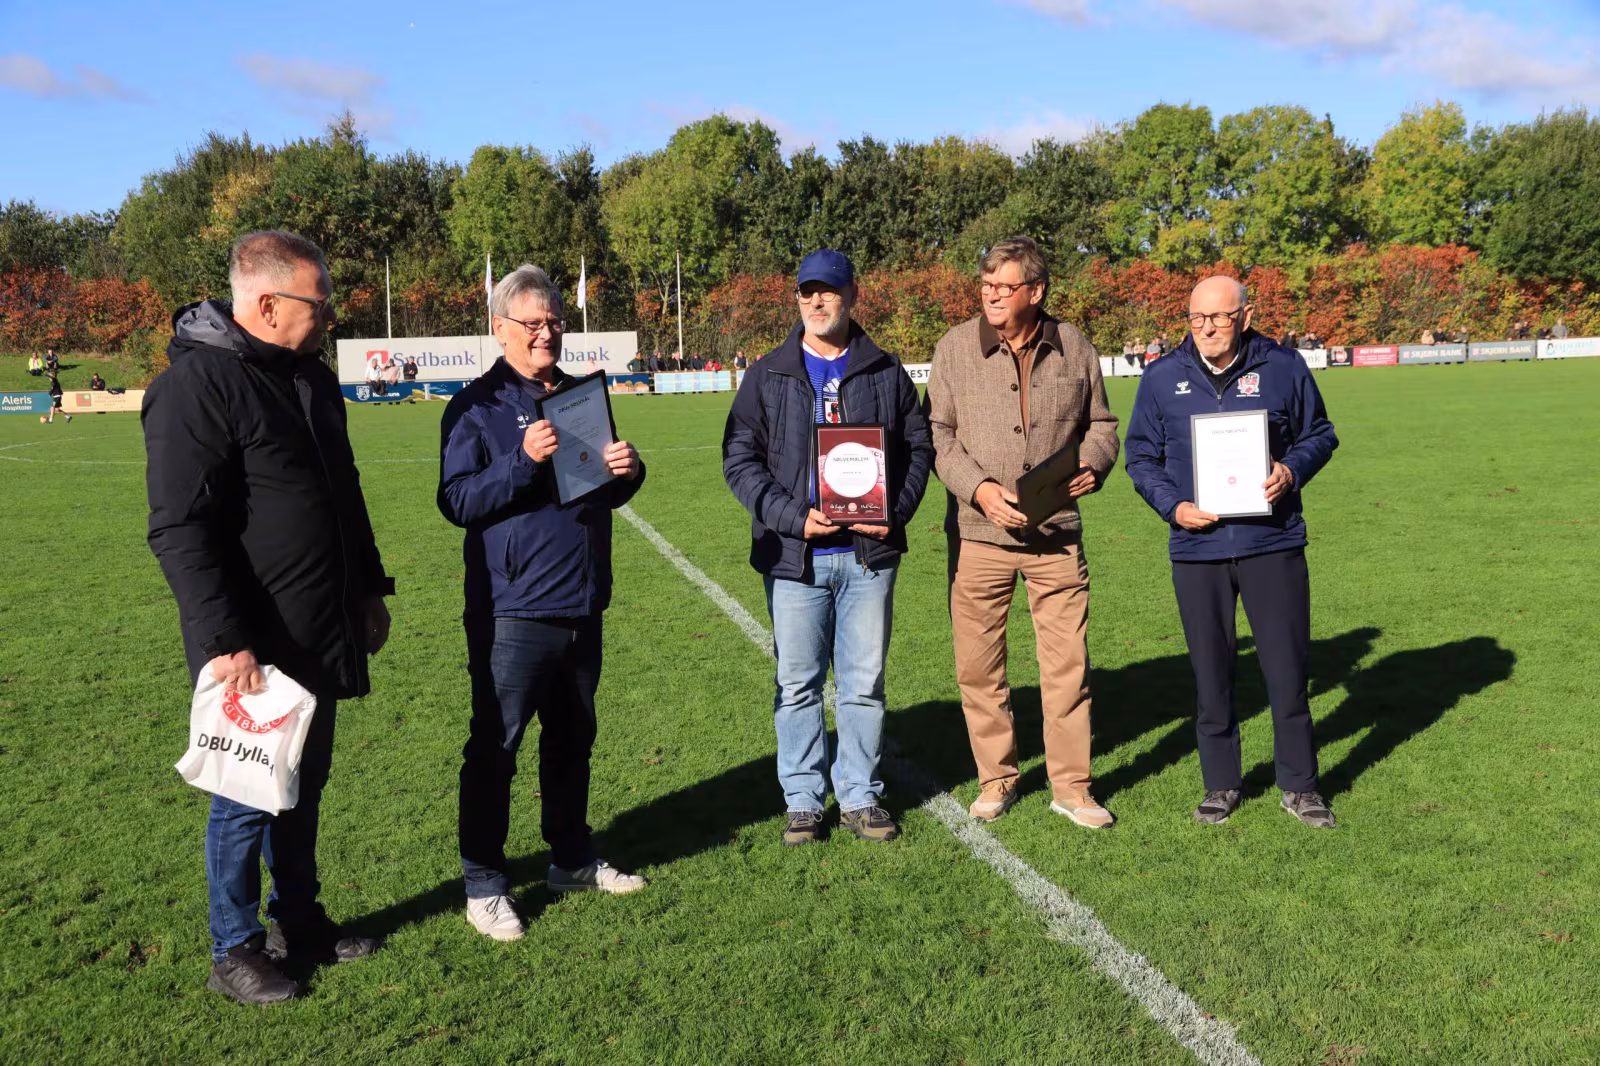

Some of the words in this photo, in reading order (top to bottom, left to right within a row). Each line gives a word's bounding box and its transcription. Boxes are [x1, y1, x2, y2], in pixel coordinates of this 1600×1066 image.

[560, 346, 610, 362] bank
[1440, 348, 1462, 356] BANK
[905, 369, 930, 379] EST
[2, 395, 32, 405] Aleris
[197, 733, 233, 752] DBU
